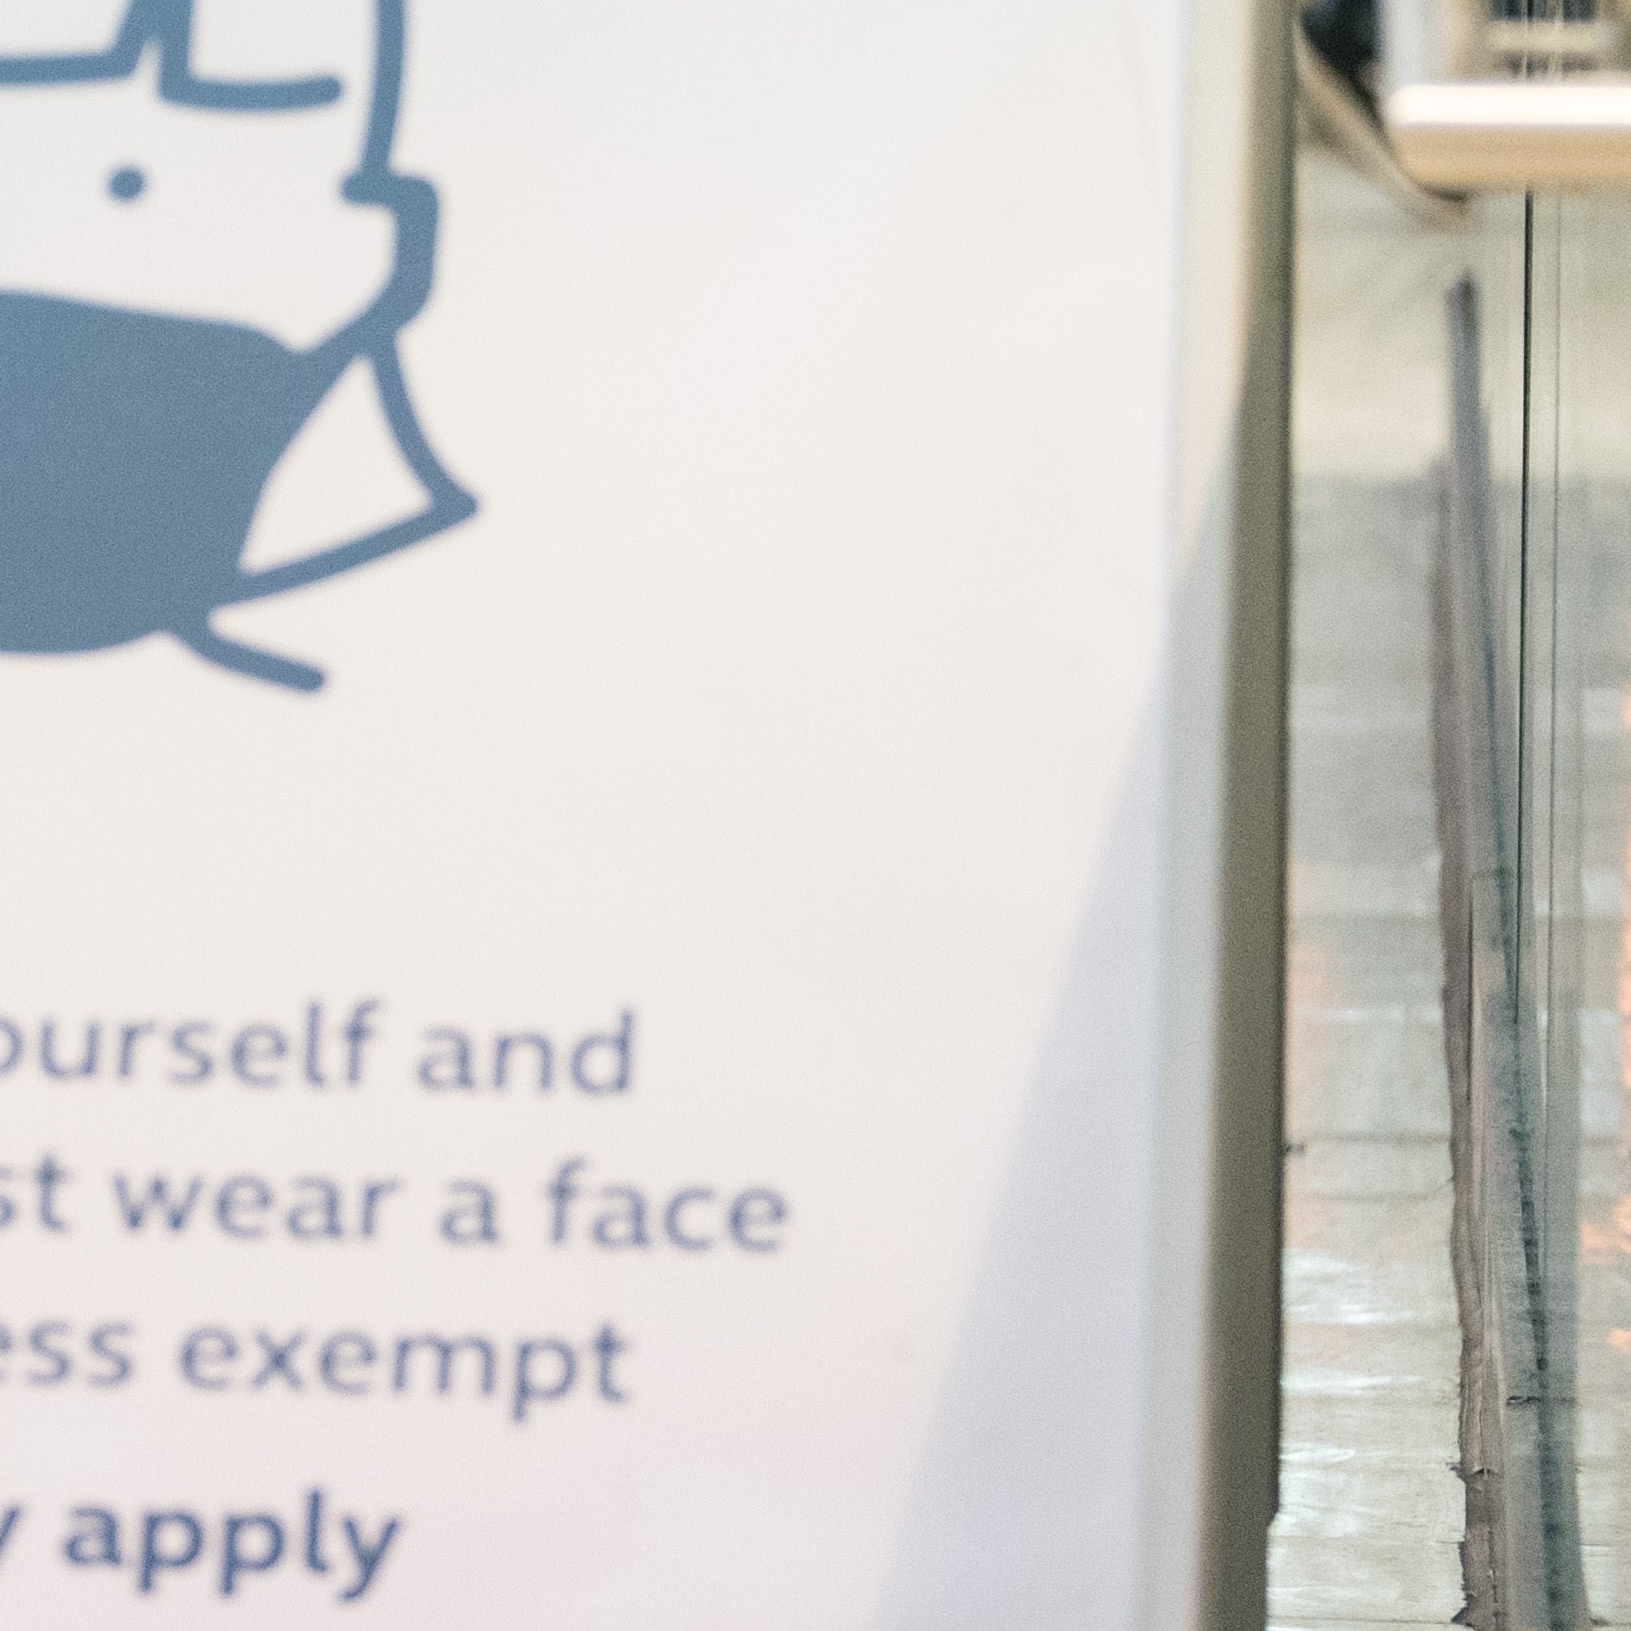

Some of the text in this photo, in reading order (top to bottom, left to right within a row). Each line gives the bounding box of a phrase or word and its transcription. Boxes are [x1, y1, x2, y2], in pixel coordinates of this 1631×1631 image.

[416, 1009, 636, 1097] and
[113, 1176, 397, 1241] wear
[439, 1181, 500, 1245] a
[545, 1158, 789, 1254] face
[177, 1323, 627, 1424] exempt
[62, 1488, 401, 1603] apply
